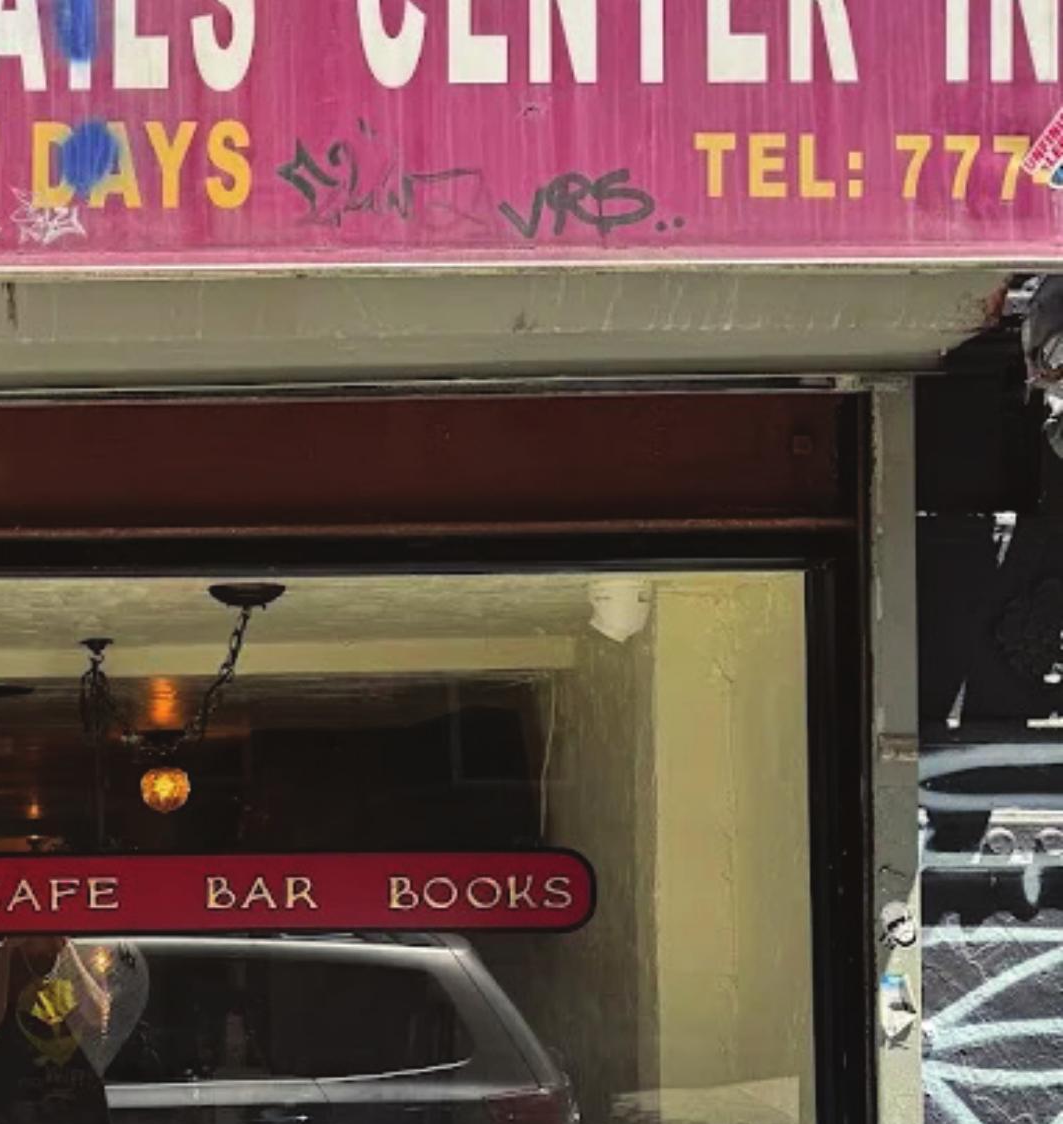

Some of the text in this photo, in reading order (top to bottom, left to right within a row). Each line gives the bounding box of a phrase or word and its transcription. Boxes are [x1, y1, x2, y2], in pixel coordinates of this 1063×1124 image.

[694, 133, 864, 198] TEL:
[206, 876, 319, 910] BAR
[388, 875, 573, 910] BOOKS
